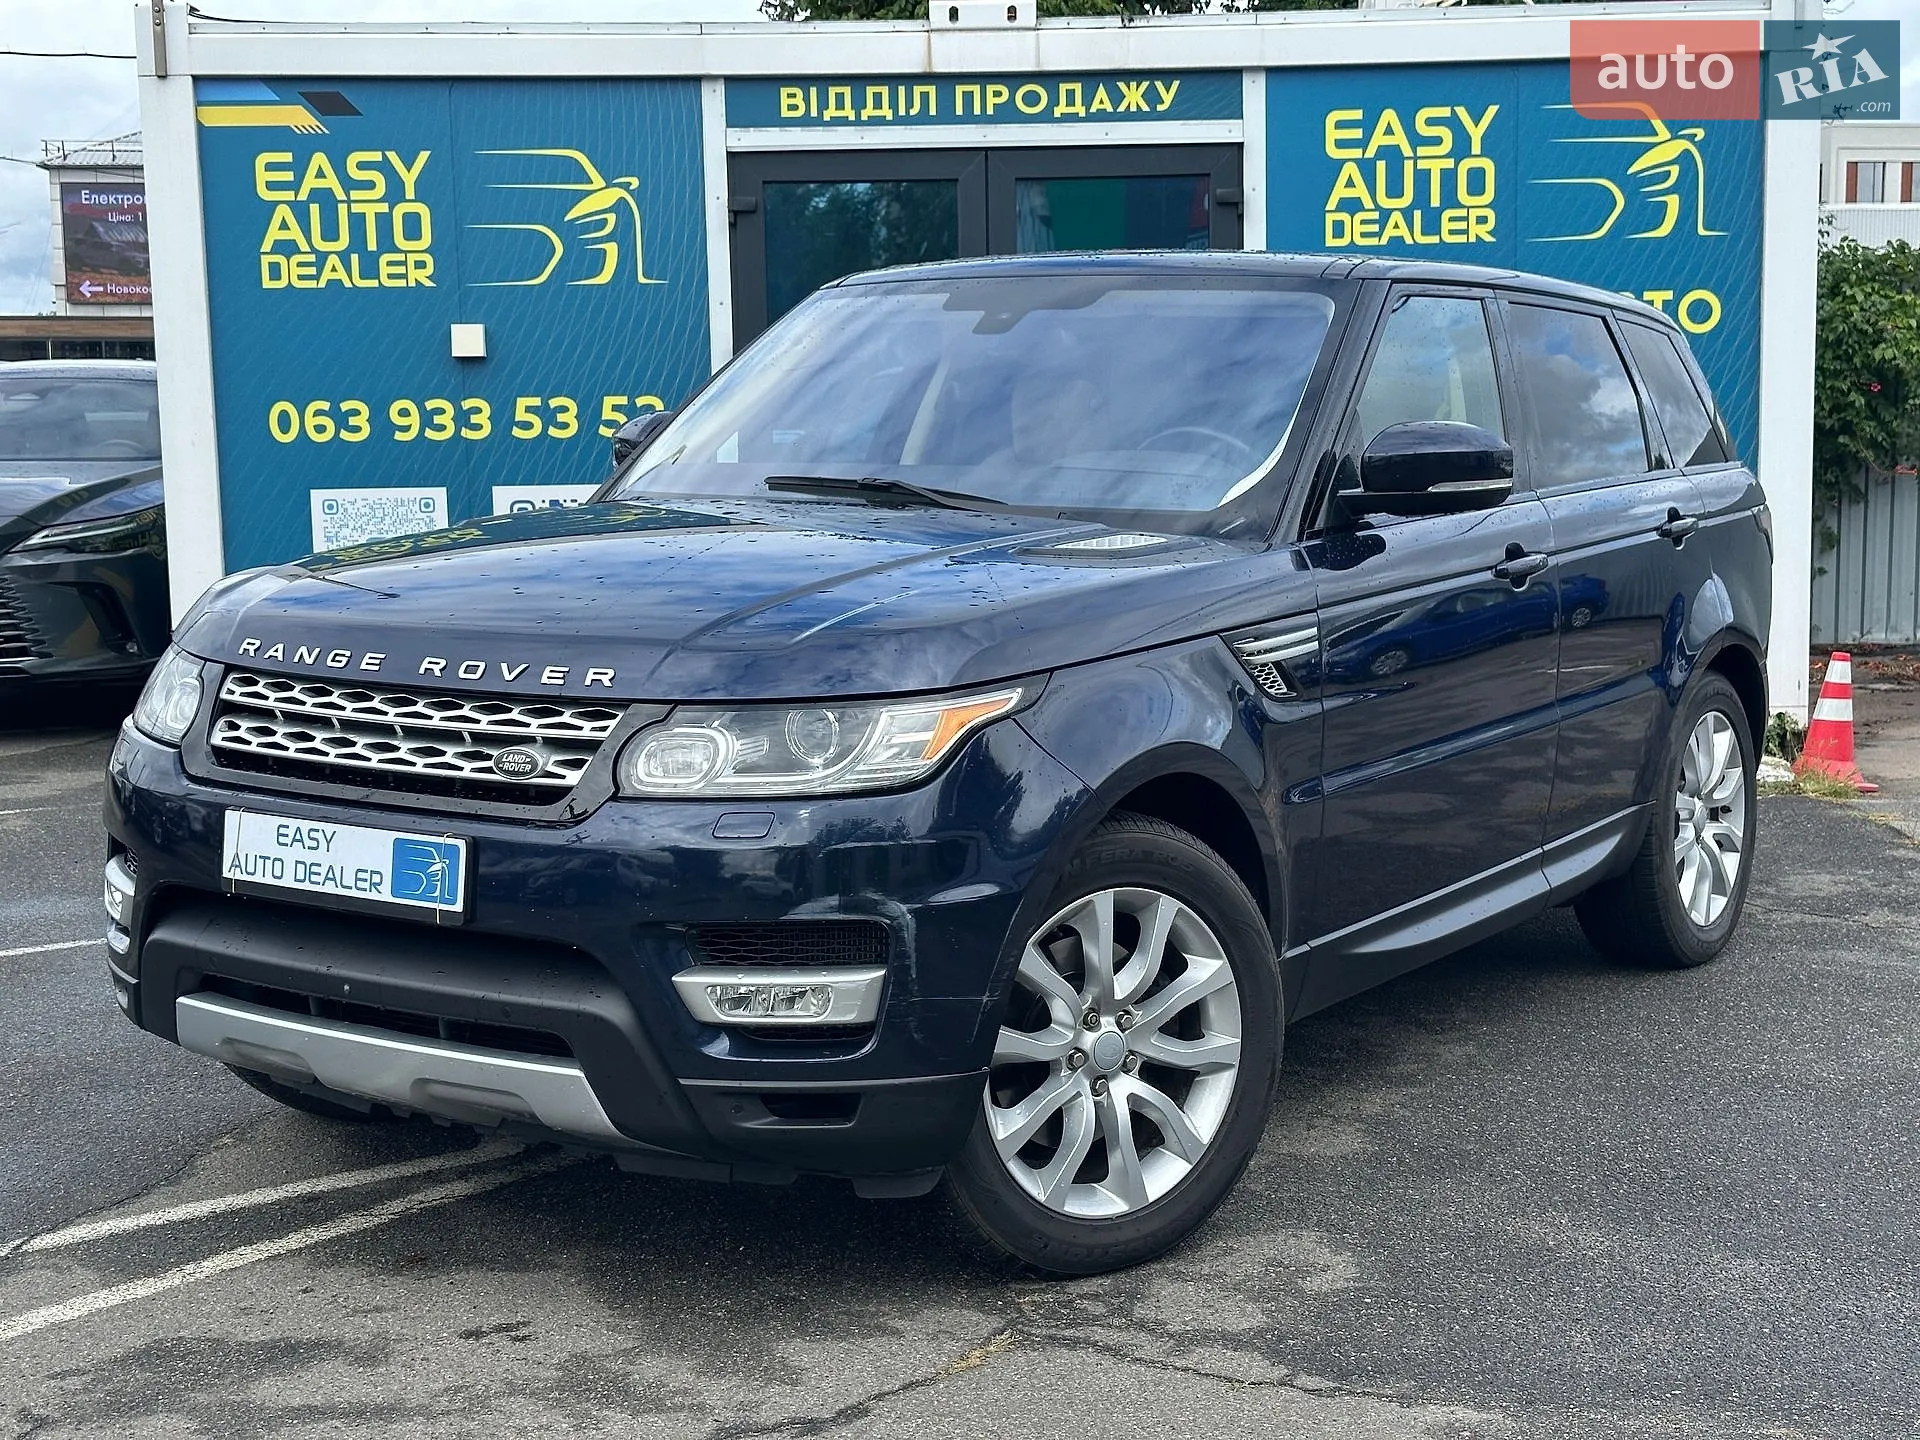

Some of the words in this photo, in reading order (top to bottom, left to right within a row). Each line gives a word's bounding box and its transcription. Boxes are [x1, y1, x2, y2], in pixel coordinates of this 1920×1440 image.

[779, 85, 937, 121] ВІДДІЛ
[955, 80, 1181, 118] ПРОДАЖУ
[1325, 105, 1500, 160] EASY
[255, 150, 432, 201] EASY
[1324, 156, 1496, 211] AUTO
[81, 189, 146, 209] Електро
[108, 211, 134, 223] Ціна:
[259, 202, 432, 253] AUTO
[1325, 207, 1497, 247] DEALER
[260, 253, 437, 289] DEALER
[269, 400, 370, 444] 063
[389, 398, 492, 442] 933
[512, 396, 579, 439] 53
[238, 637, 387, 671] RANGE
[418, 655, 616, 688] ROVER
[276, 823, 337, 853] EASY
[227, 852, 285, 881] AUTO
[293, 859, 384, 895] DEALER
